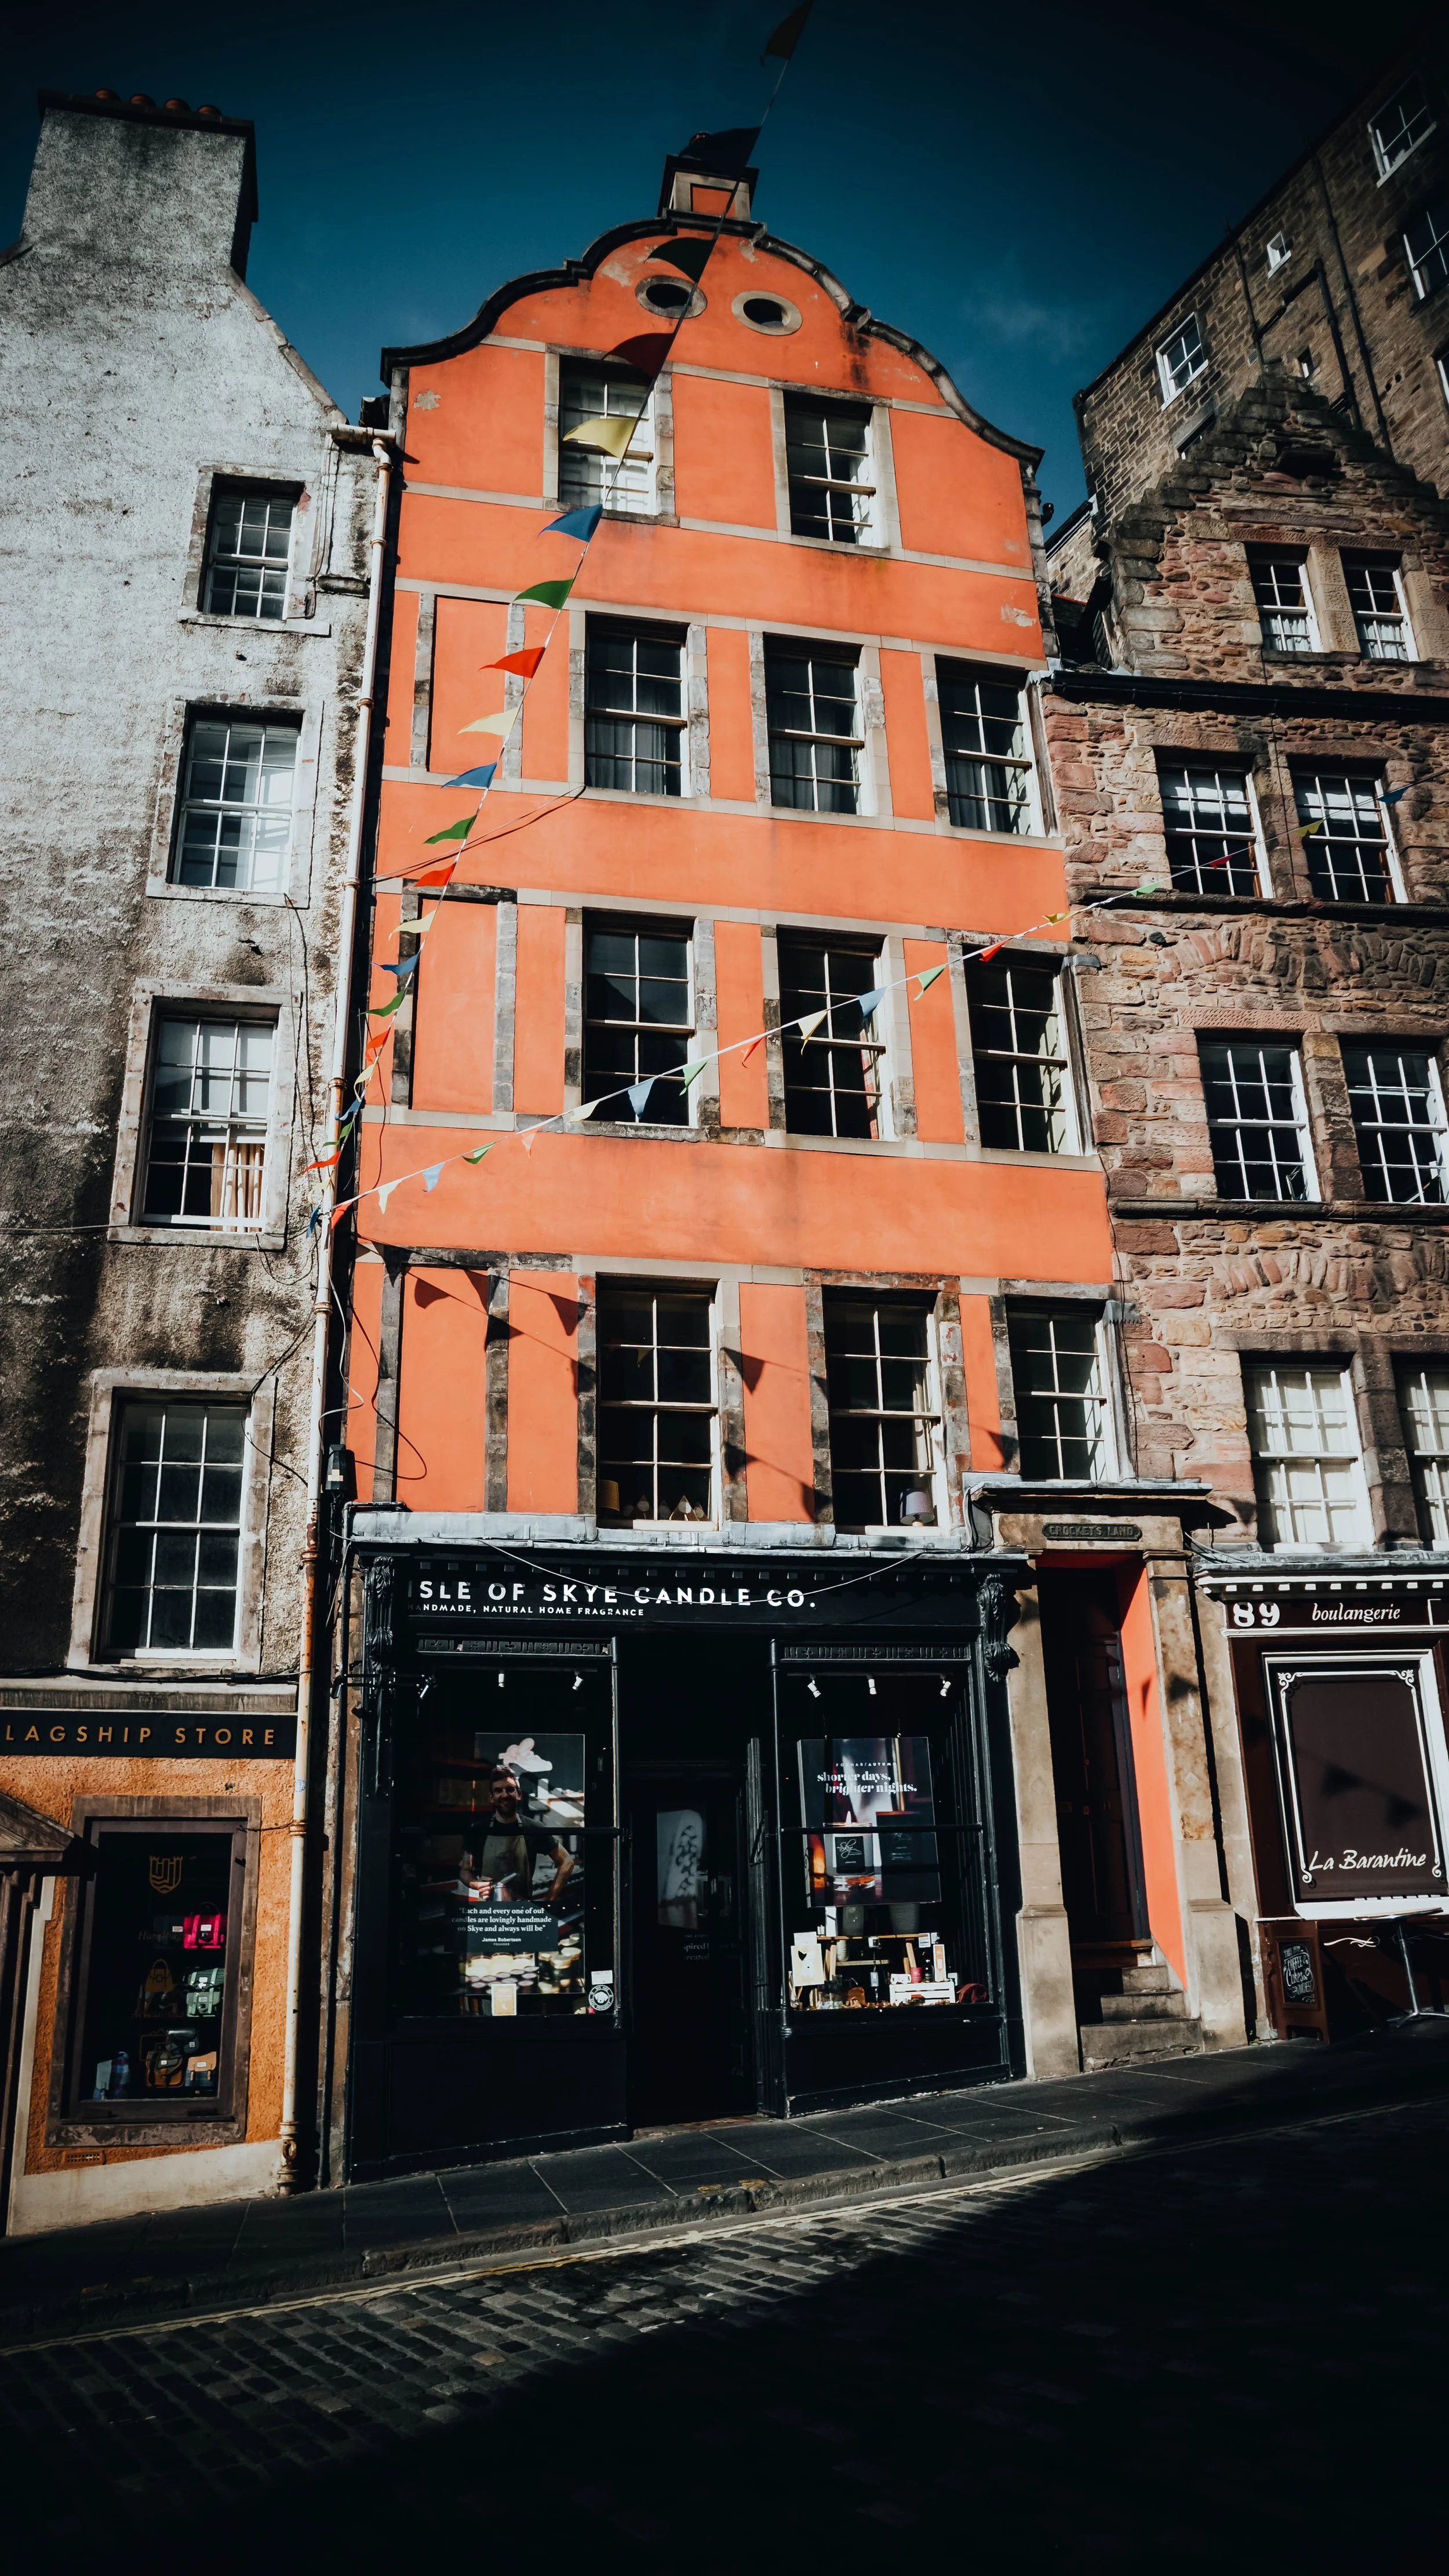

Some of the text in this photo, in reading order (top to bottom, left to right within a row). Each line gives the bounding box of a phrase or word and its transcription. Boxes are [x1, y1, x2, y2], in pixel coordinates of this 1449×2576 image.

[1108, 1526, 1133, 1536] LAND
[488, 1582, 526, 1601] OF
[543, 1583, 617, 1603] SKYE
[634, 1586, 751, 1605] CANDLE
[766, 1589, 815, 1607] CO.
[407, 1604, 476, 1614] HANDMADE,
[483, 1605, 533, 1614] NATURAL
[577, 1608, 644, 1616] FRAGRANCE
[1233, 1601, 1280, 1627] 89
[1312, 1603, 1400, 1623] boulangerie
[5, 1725, 275, 1745] LAGSHIP STORE
[817, 1771, 891, 1783] shorter days,
[876, 1782, 917, 1795] nights.
[1309, 1848, 1426, 1870] La Barantine
[489, 1916, 516, 1924] lovingly
[467, 1925, 483, 1933] Skye
[498, 1925, 520, 1933] always
